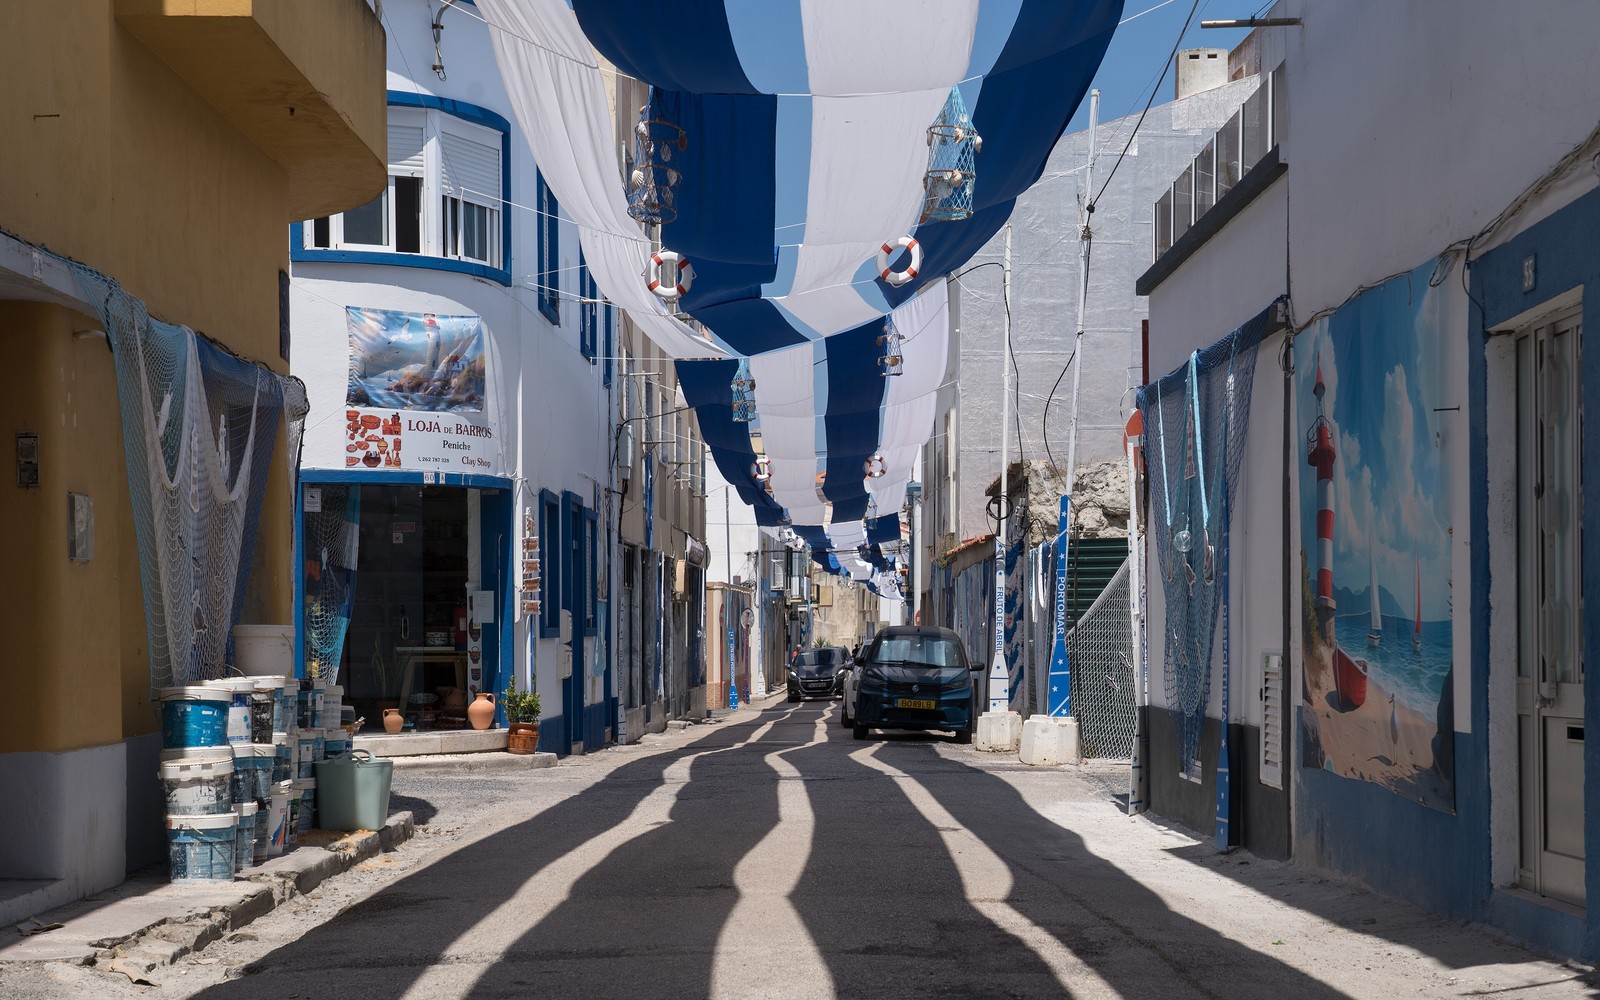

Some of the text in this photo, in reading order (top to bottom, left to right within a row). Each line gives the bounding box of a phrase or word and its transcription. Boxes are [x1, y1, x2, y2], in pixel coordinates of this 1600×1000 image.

[408, 420, 441, 433] LOJA
[456, 423, 492, 439] BARROS
[443, 440, 471, 451] Peniche
[461, 456, 491, 469] Clay Shop
[1057, 576, 1065, 635] PORTOMAR
[997, 616, 1003, 628] DE
